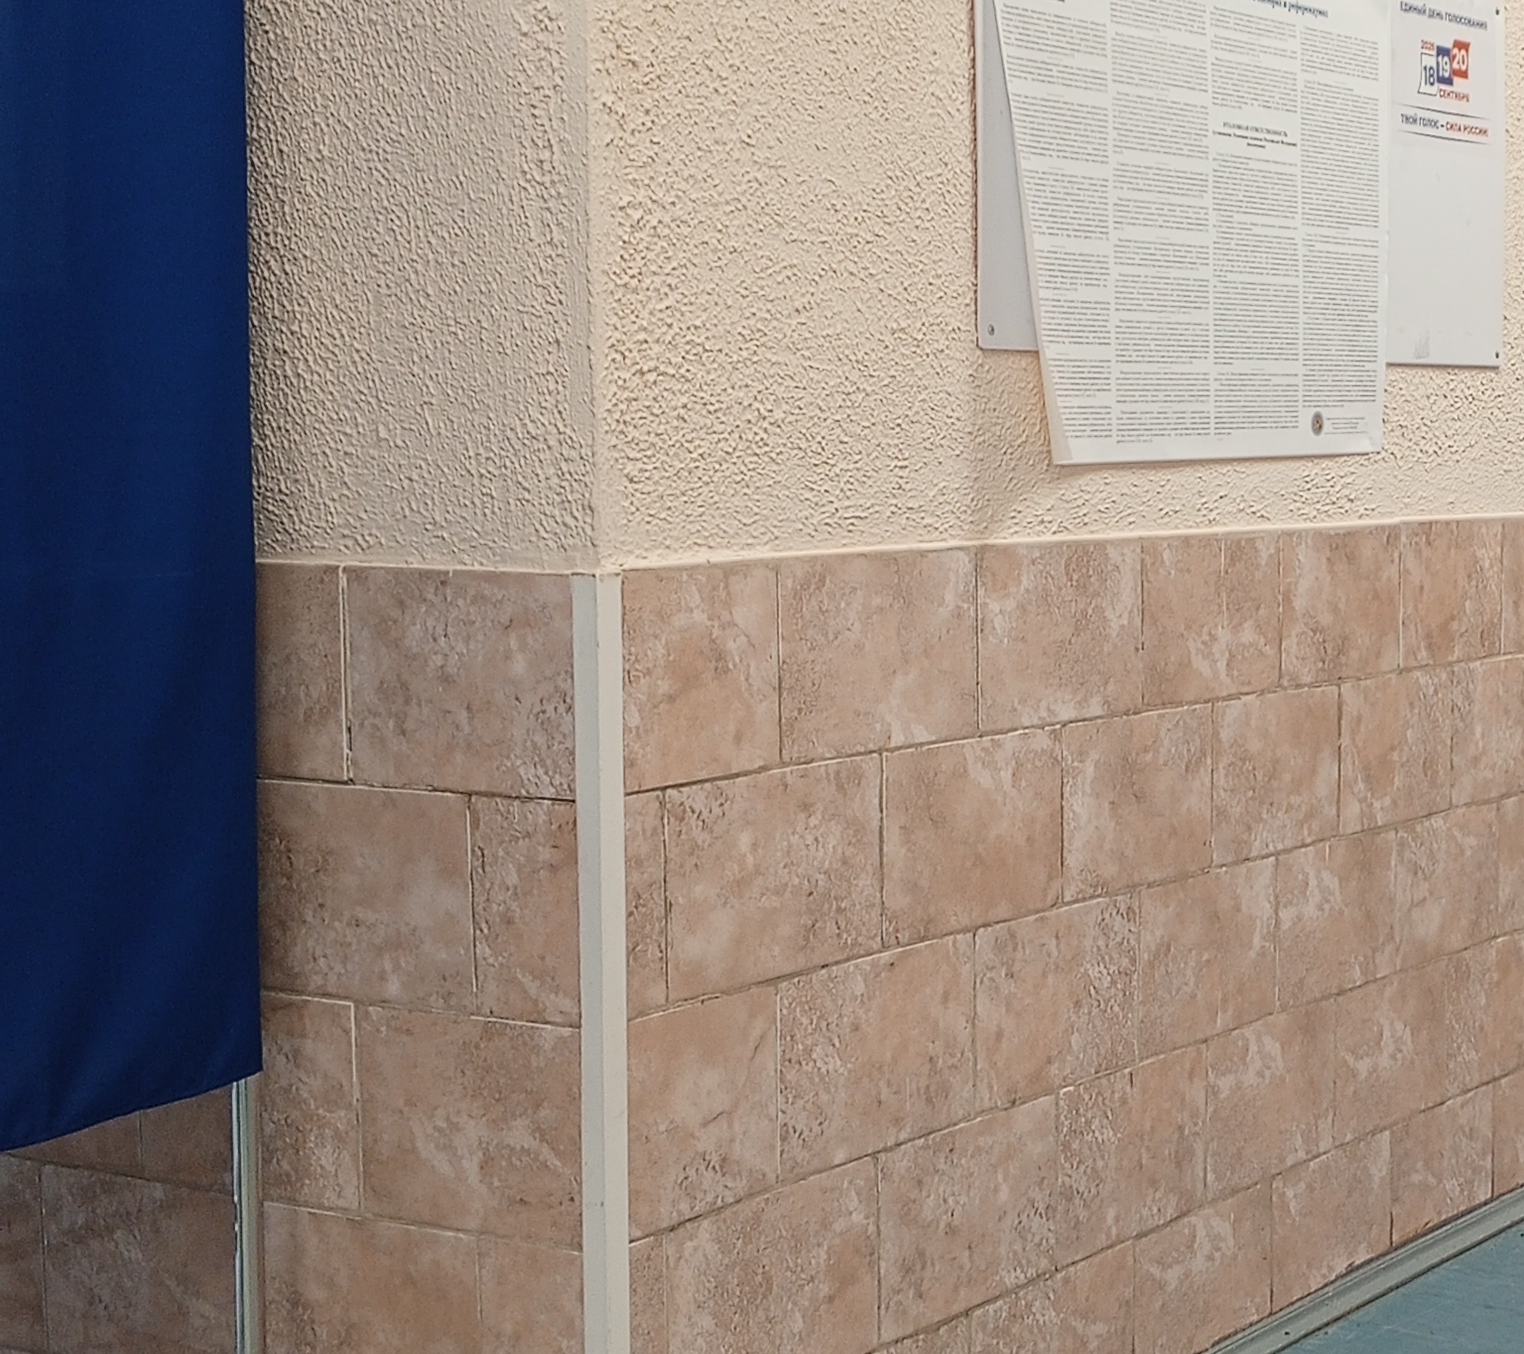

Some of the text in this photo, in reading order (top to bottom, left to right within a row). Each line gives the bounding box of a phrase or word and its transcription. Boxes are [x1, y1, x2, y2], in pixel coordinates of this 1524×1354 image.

[1400, 1, 1488, 31] ЕДИНЫЙ ДЕНЬ ГОЛОСОВАНИЯ
[1437, 55, 1451, 78] 19
[1452, 47, 1468, 72] 20
[1423, 65, 1436, 86] 18
[1439, 88, 1470, 103] СЕНТЯБРЯ
[1400, 112, 1418, 124] ТВОЙ
[1419, 117, 1440, 130] ГОЛОС
[1445, 121, 1461, 132] СИЛА
